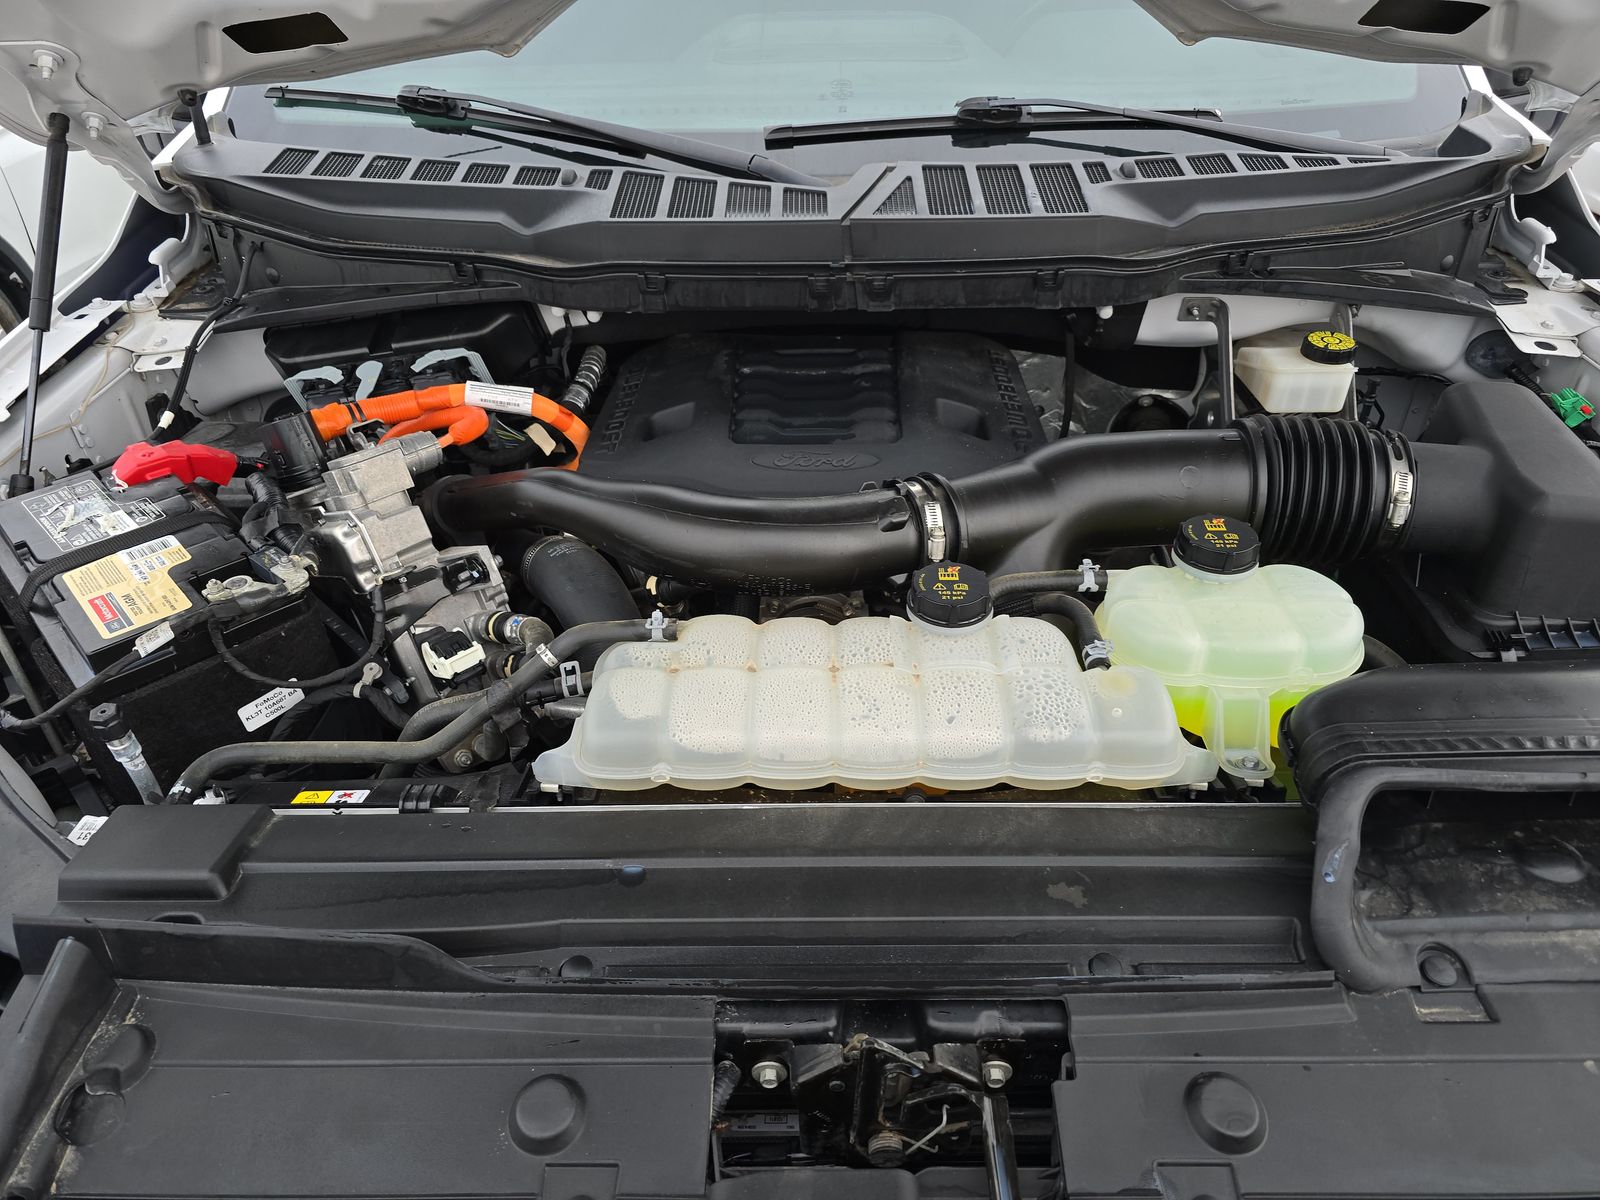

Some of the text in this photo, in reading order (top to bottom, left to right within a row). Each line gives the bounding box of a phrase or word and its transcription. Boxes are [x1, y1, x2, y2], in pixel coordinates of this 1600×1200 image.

[773, 451, 859, 468] Ford
[120, 592, 137, 607] AGM
[93, 597, 113, 620] Motorcraft
[255, 691, 283, 709] FoMoCo
[245, 708, 263, 722] KL3T
[264, 703, 286, 718] C500L
